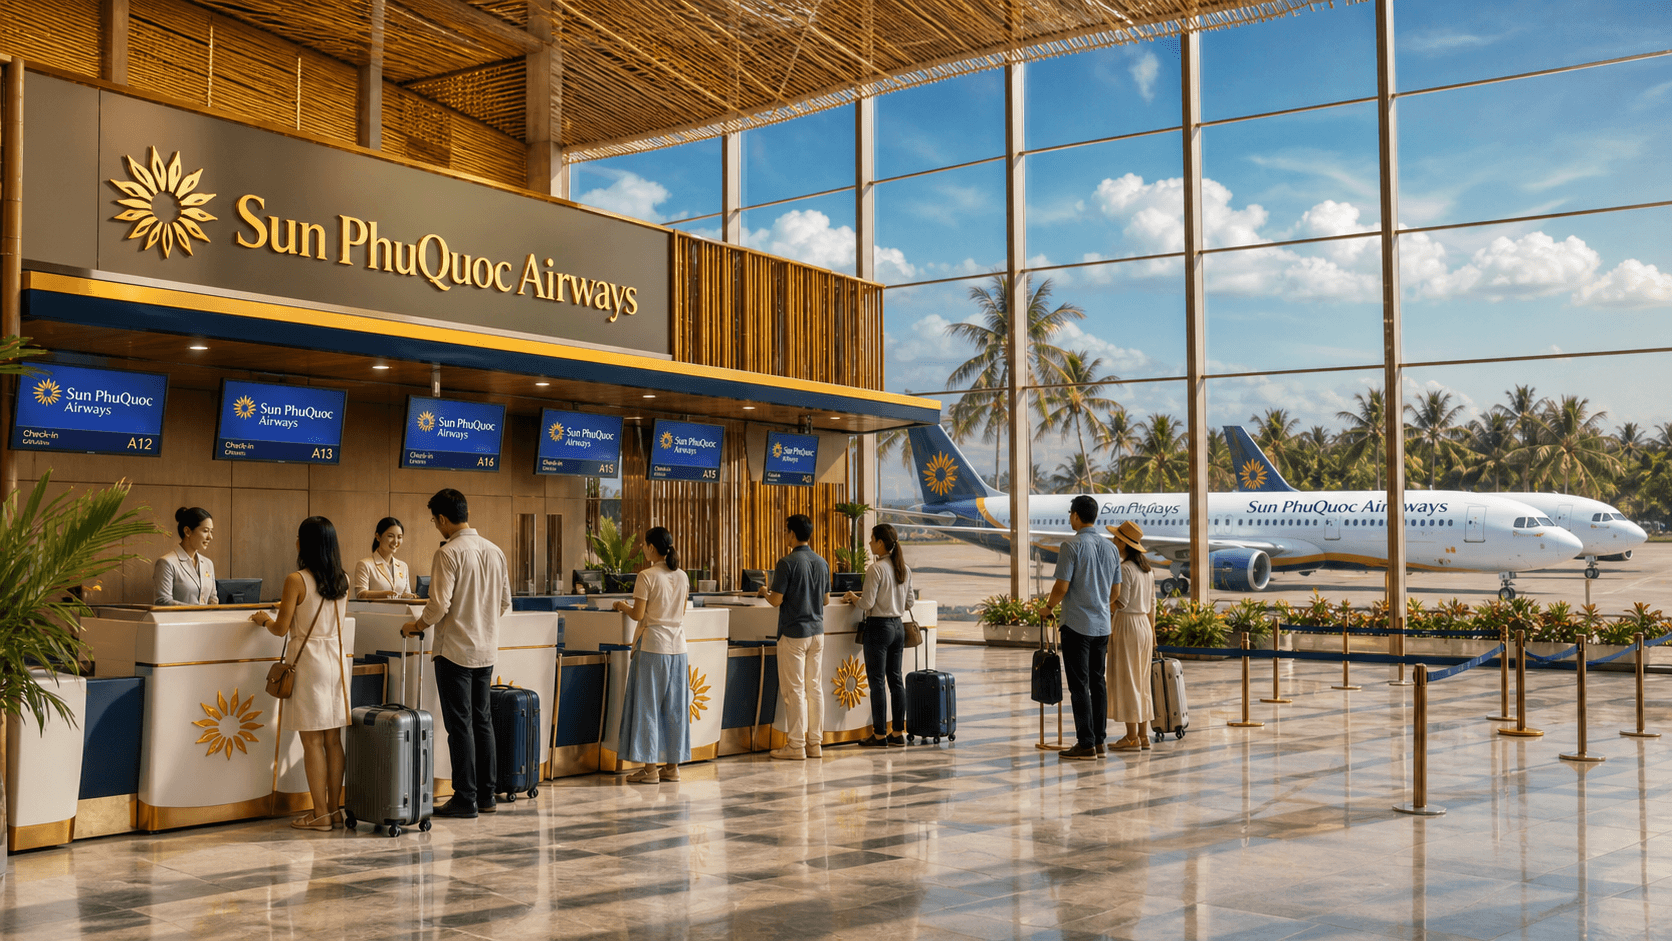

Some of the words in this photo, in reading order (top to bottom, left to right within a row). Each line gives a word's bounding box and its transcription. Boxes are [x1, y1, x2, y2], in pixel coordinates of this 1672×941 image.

[234, 194, 328, 261] Sun
[337, 213, 513, 293] PhuQuoc
[517, 253, 639, 323] Airways
[66, 387, 92, 402] Sun
[95, 389, 154, 407] PhuQuoc
[64, 402, 112, 418] Airways
[260, 402, 281, 416] Sun
[284, 404, 334, 420] PhuQuoc
[258, 416, 299, 430] Airways
[438, 416, 456, 428] Sun
[457, 418, 496, 432] PhuQuoc
[437, 428, 469, 441] Airways
[566, 427, 581, 437] Sun
[582, 428, 615, 441] PhuQuoc
[127, 437, 153, 450] A12
[311, 448, 333, 460] A13
[476, 457, 495, 467] A16
[1246, 500, 1278, 514] Sun
[1282, 500, 1358, 516] PhuQuoc
